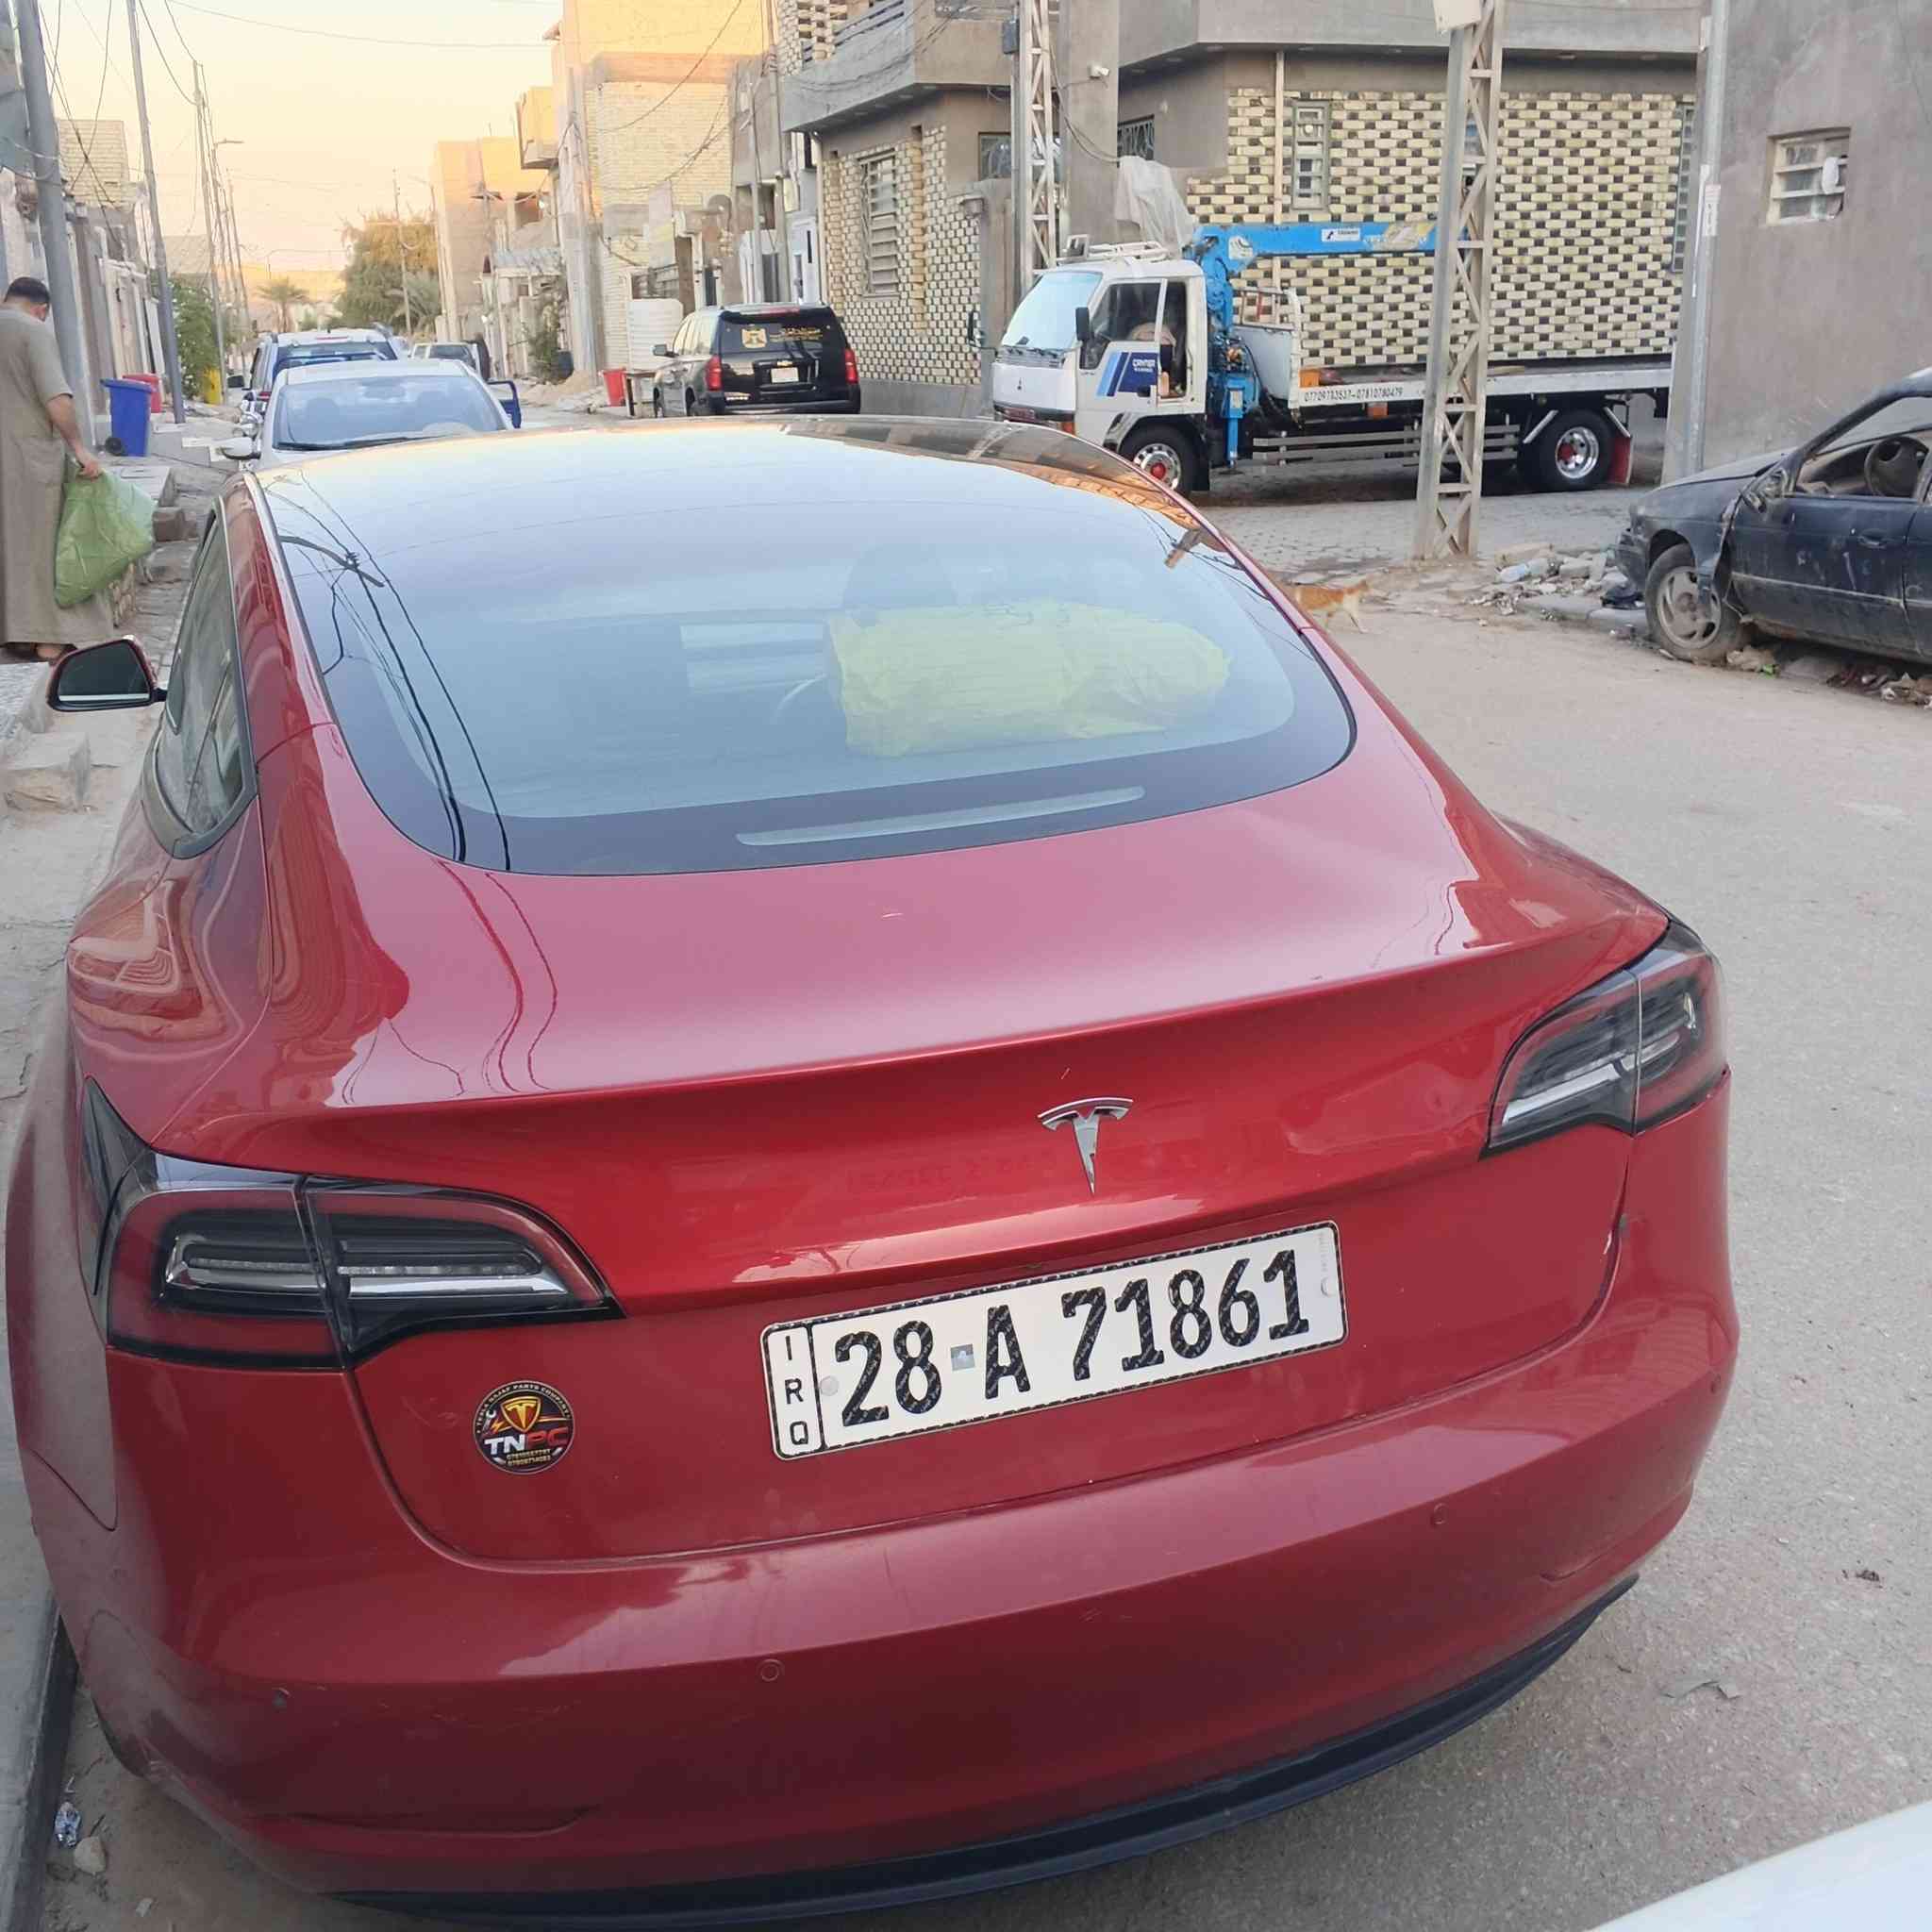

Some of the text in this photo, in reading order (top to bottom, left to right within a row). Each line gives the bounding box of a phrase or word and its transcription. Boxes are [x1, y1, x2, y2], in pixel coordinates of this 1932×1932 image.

[785, 1335, 808, 1445] IRQ
[835, 1321, 941, 1426] 28
[985, 1305, 1031, 1400] A
[1061, 1249, 1309, 1381] 71861
[483, 1426, 569, 1456] TNPC
